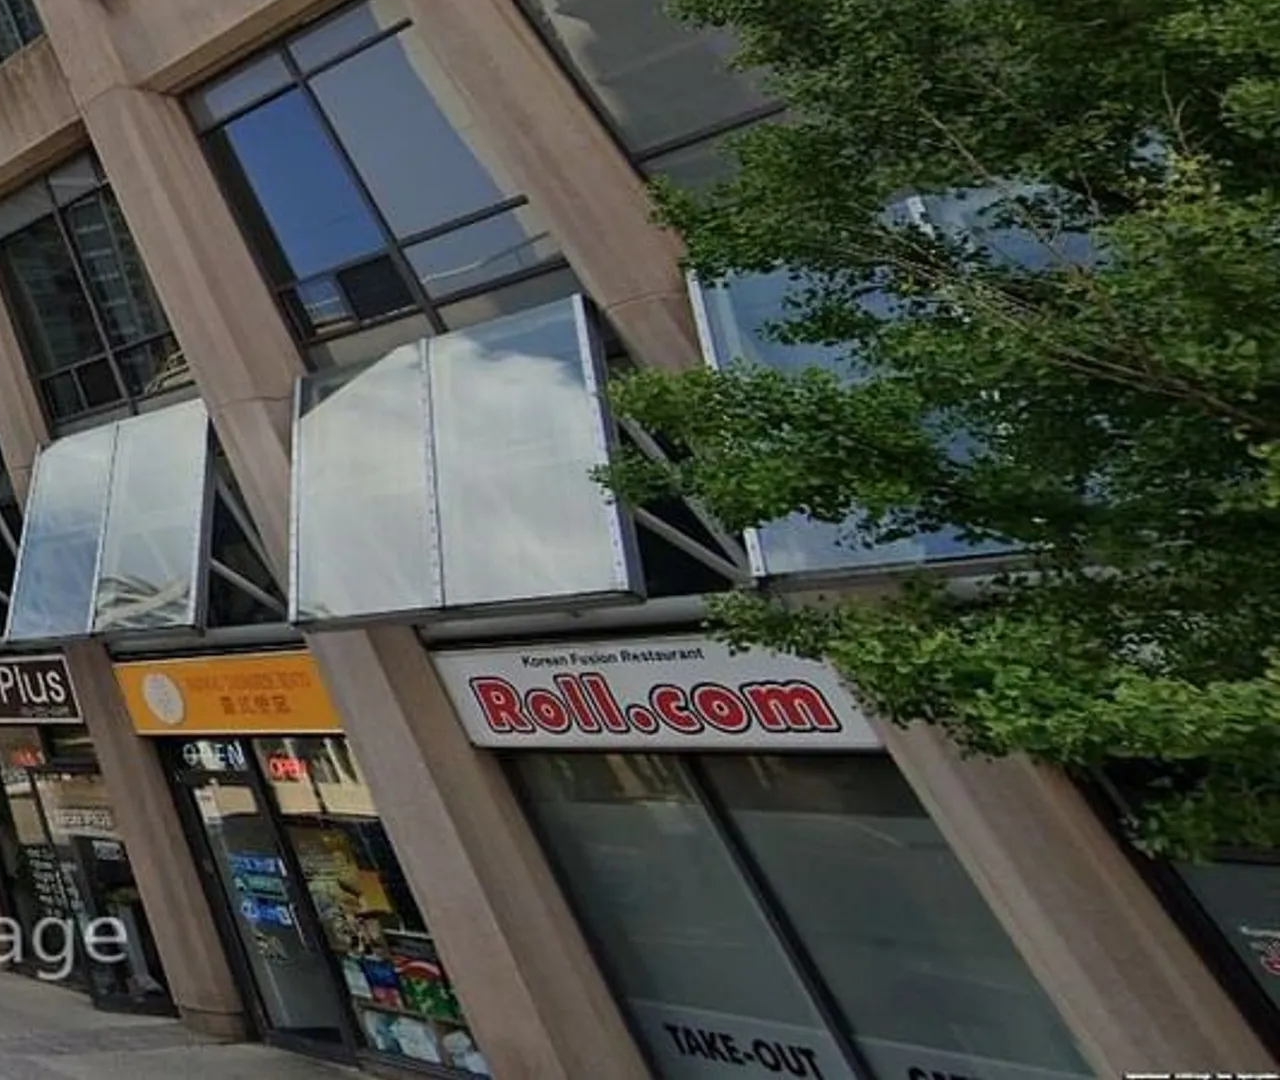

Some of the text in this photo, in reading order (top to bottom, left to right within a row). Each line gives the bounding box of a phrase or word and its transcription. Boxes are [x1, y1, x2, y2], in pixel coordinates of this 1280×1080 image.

[521, 647, 706, 668] Korean Fusion Restaurant
[470, 673, 842, 735] Roll.com
[665, 1023, 822, 1080] TAKE-OUT
